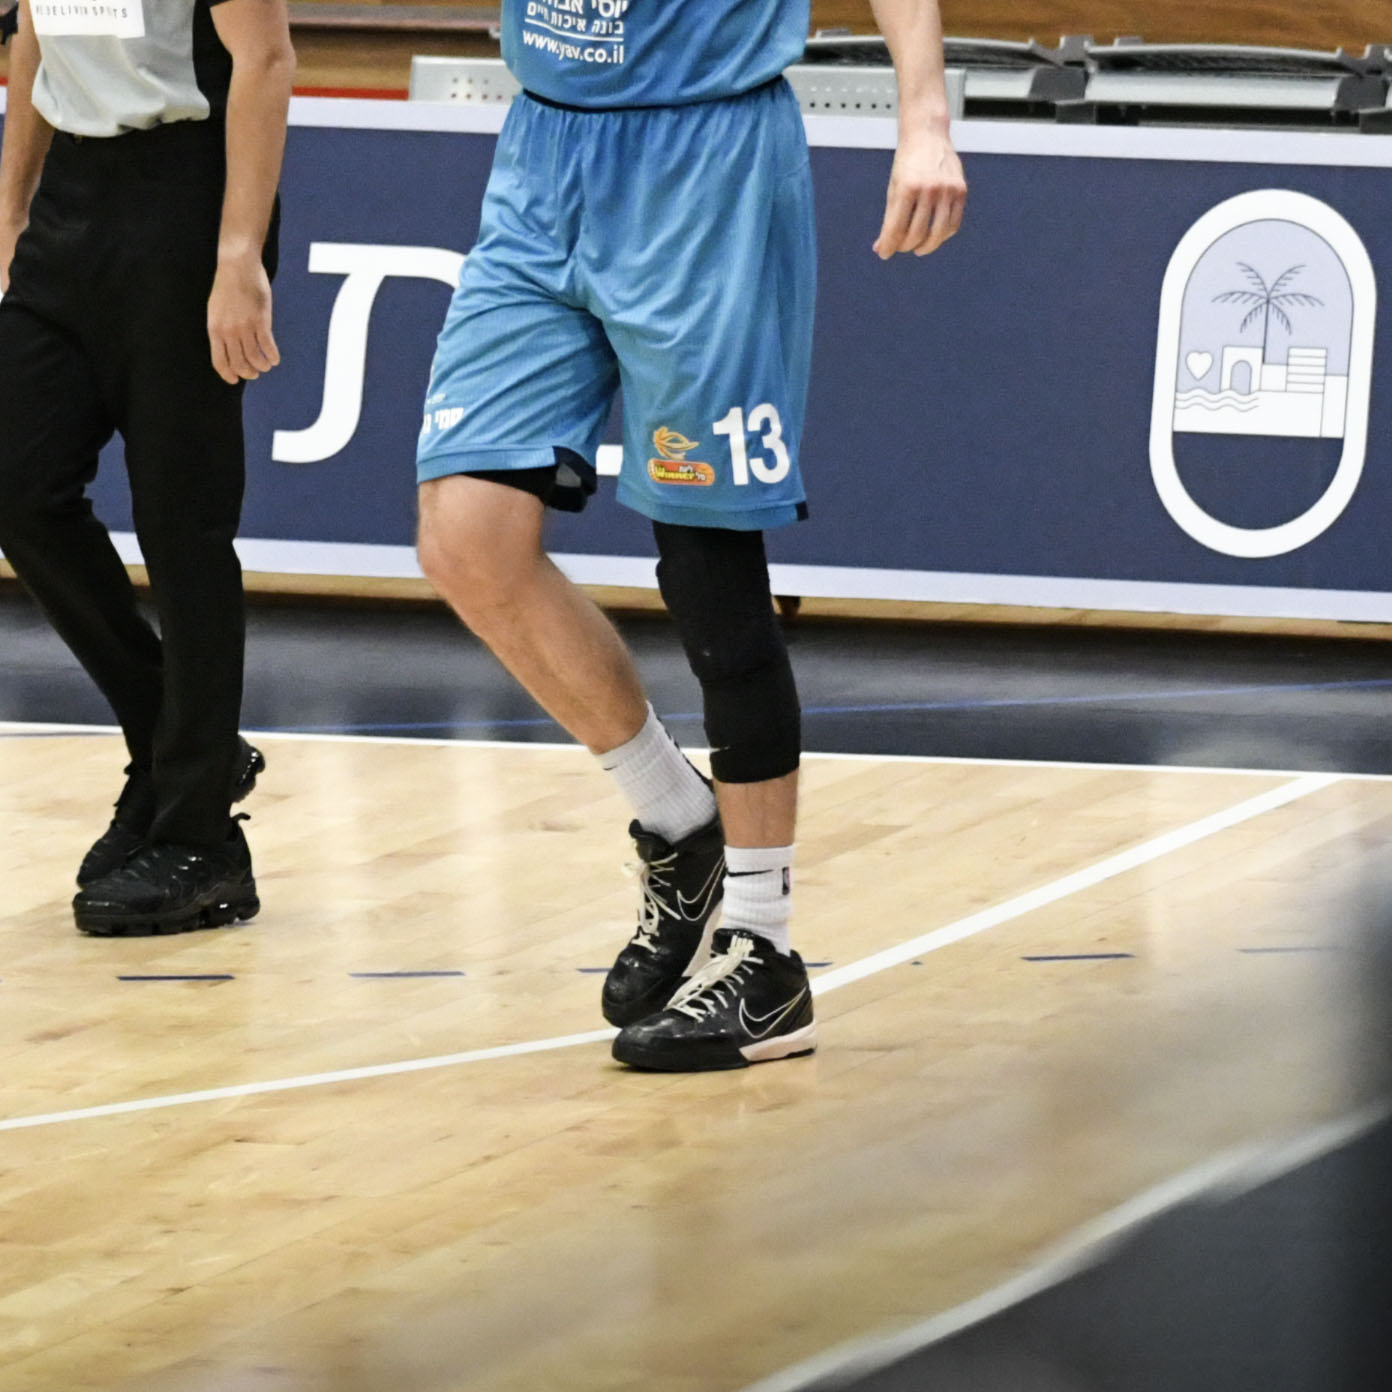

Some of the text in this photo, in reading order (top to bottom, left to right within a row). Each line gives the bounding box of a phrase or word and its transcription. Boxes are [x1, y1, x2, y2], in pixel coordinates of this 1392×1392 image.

[550, 11, 587, 33] איכות
[591, 19, 625, 35] בונה
[522, 30, 625, 64] www.yav.co.il
[712, 403, 791, 486] 13
